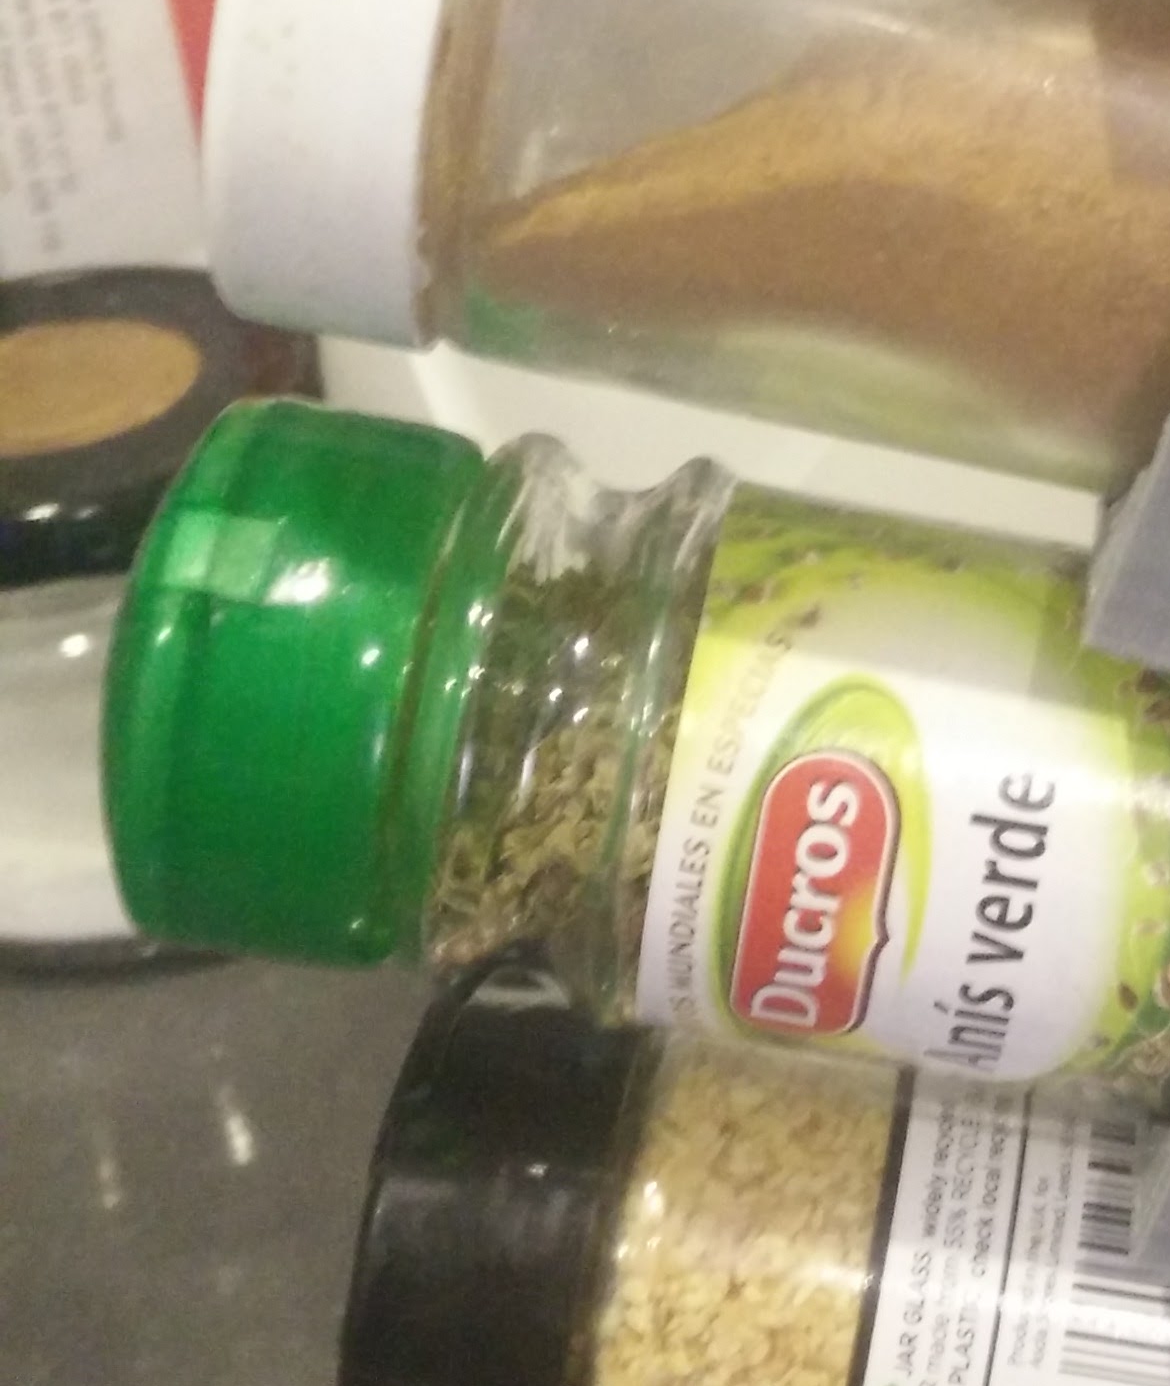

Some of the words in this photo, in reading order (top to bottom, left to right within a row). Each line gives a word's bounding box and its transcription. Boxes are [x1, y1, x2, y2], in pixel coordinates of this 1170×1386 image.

[666, 839, 709, 988] MUNDIALES
[690, 784, 725, 828] EN
[750, 778, 860, 1027] Ducros
[923, 983, 1016, 1071] Anís
[970, 774, 1056, 964] verde
[977, 1168, 1001, 1209] local
[968, 1218, 995, 1278] check
[903, 1251, 932, 1326] GLASS
[895, 1334, 919, 1377] JAR
